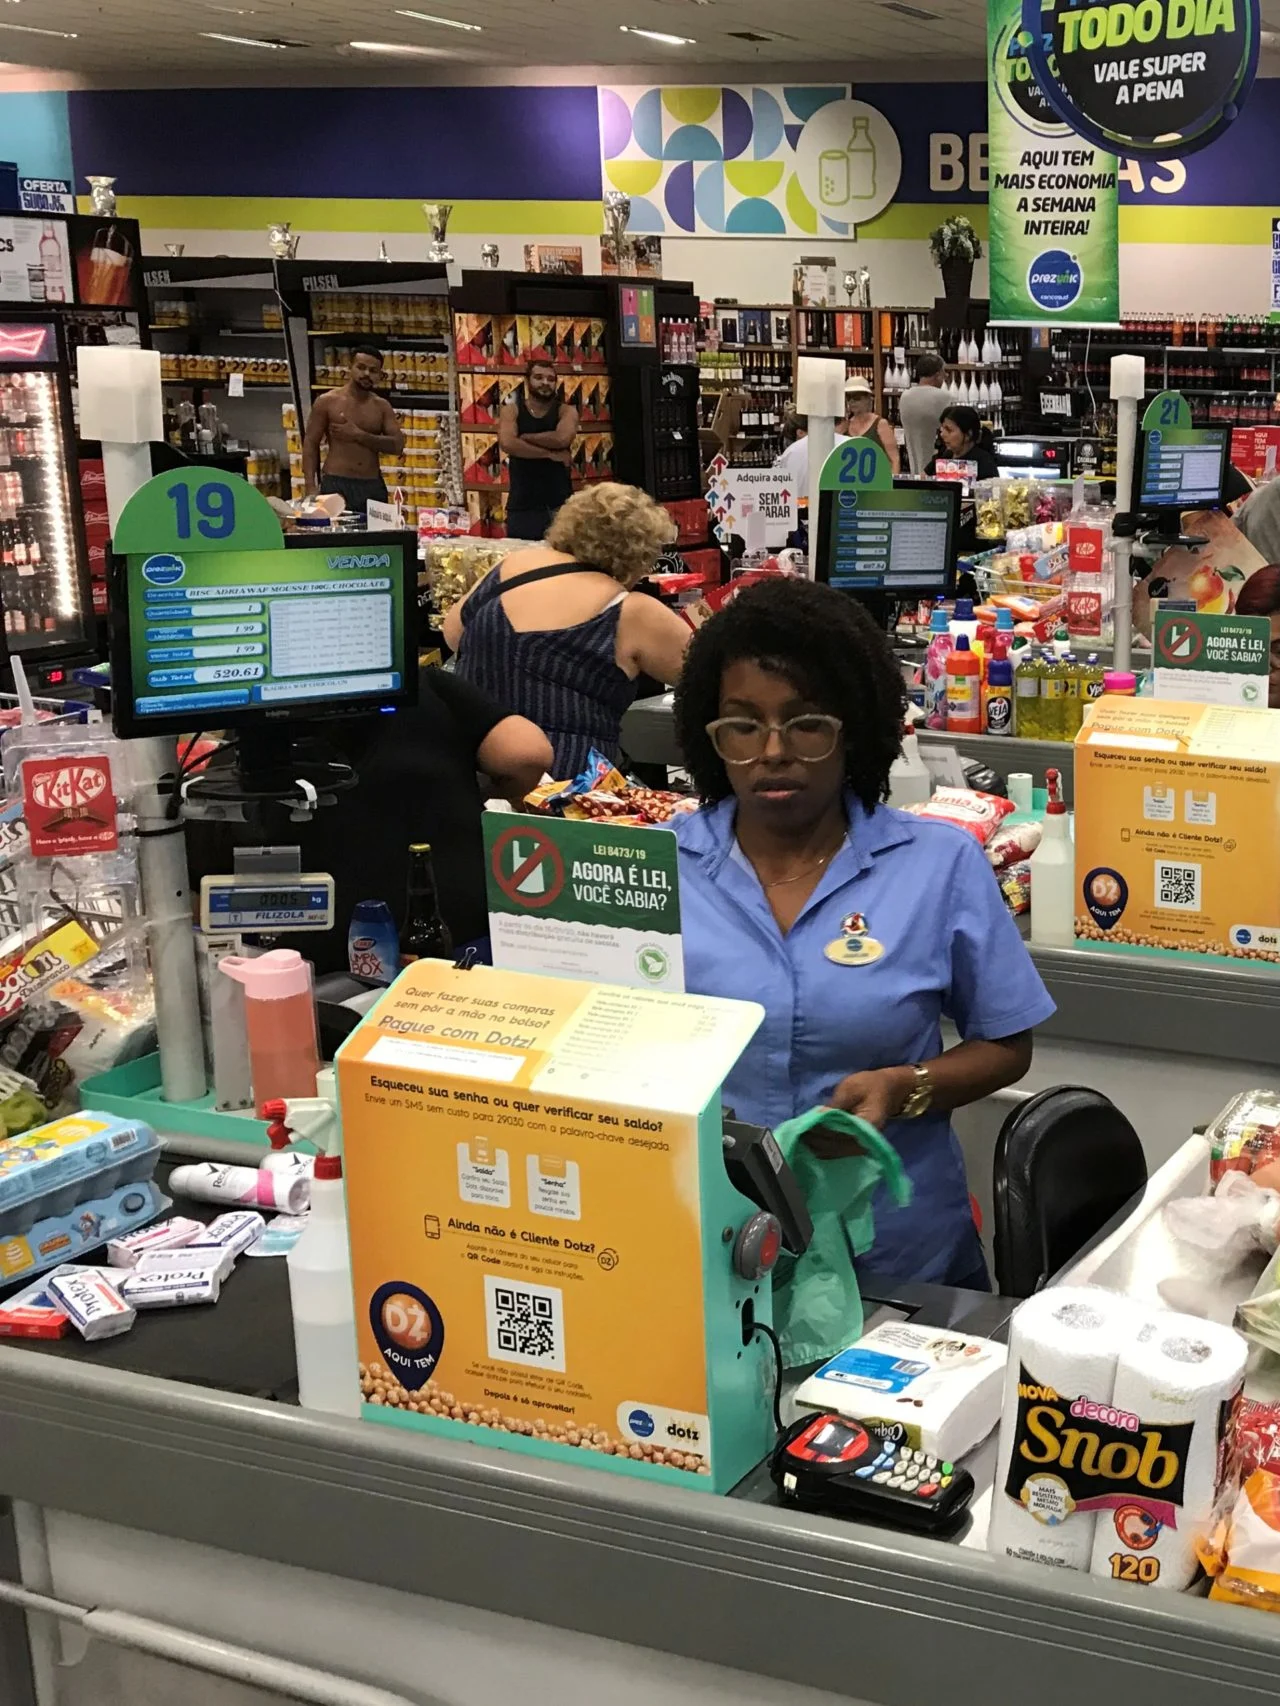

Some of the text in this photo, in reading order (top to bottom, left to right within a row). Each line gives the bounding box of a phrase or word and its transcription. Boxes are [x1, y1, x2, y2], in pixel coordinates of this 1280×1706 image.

[1058, 1, 1163, 54] TODO
[1094, 52, 1206, 83] VALE SUPER
[1116, 79, 1184, 105] A PENA
[1020, 151, 1094, 169] AQUI TEM
[24, 180, 67, 192] OFERTA
[995, 174, 1116, 189] MAIS ECONOMIA
[1017, 197, 1096, 212] A SEMANA
[1024, 220, 1089, 235] INTEIRA!
[302, 274, 338, 291] PILSEN
[1160, 398, 1180, 425] 21
[839, 447, 877, 484] 20
[737, 474, 793, 483] Adquira aqui.
[759, 493, 779, 505] SEM
[166, 482, 236, 540] 19
[326, 554, 390, 569] VENDA
[332, 582, 386, 590] CHOCOLATE
[1207, 637, 1266, 652] AGORA É LEI,
[1207, 649, 1262, 663] VOCÊ SABIA?
[213, 667, 259, 679] 520.61
[1094, 752, 1126, 763] Esqueceu
[1129, 755, 1141, 763] sua
[1144, 756, 1165, 765] senha
[1179, 760, 1195, 768] quer
[1198, 761, 1226, 771] verificar
[1244, 765, 1267, 774] saldo?
[43, 767, 103, 807] KitKat
[1135, 828, 1223, 843] Ainda não Cliente Dotz?
[593, 845, 646, 860] LEI 8473/19
[572, 861, 672, 891] AGORA É LEI,
[573, 883, 667, 910] VOCÊ SABIA?
[1090, 905, 1121, 917] AQUI TEM
[405, 987, 555, 1017] Quer fazer suas compras
[394, 1000, 418, 1010] sem
[446, 1007, 455, 1015] a
[458, 1008, 486, 1020] mão
[489, 1013, 505, 1022] no
[509, 1015, 550, 1030] bolso?
[378, 1015, 536, 1049] Pague com Dotz!
[371, 1075, 663, 1132] Esqueceu sua senha ou quer verificar seu saldo?
[364, 1092, 386, 1105] Envie
[389, 1099, 402, 1108] um
[405, 1100, 424, 1111] SMS
[426, 1105, 444, 1114] sem
[447, 1107, 470, 1119] custo
[473, 1112, 494, 1123] para
[497, 1114, 524, 1127] 29030
[527, 1121, 546, 1131] com
[560, 1125, 625, 1145] palavra-chave
[208, 1215, 248, 1238] Protex
[448, 1218, 595, 1253] Ainda não é Cliente Dotz?
[467, 1252, 478, 1260] QR
[481, 1255, 500, 1264] Code
[138, 1272, 205, 1284] Protex
[66, 1278, 95, 1317] Protex
[383, 1348, 435, 1370] AQUI TEM
[484, 1388, 510, 1401] Depois
[1018, 1382, 1060, 1402] NOVA
[1070, 1396, 1140, 1432] decora
[667, 1423, 700, 1442] dotz
[1020, 1405, 1179, 1488] Snob
[1039, 1486, 1056, 1494] MAIS
[1109, 1552, 1160, 1584] 120
